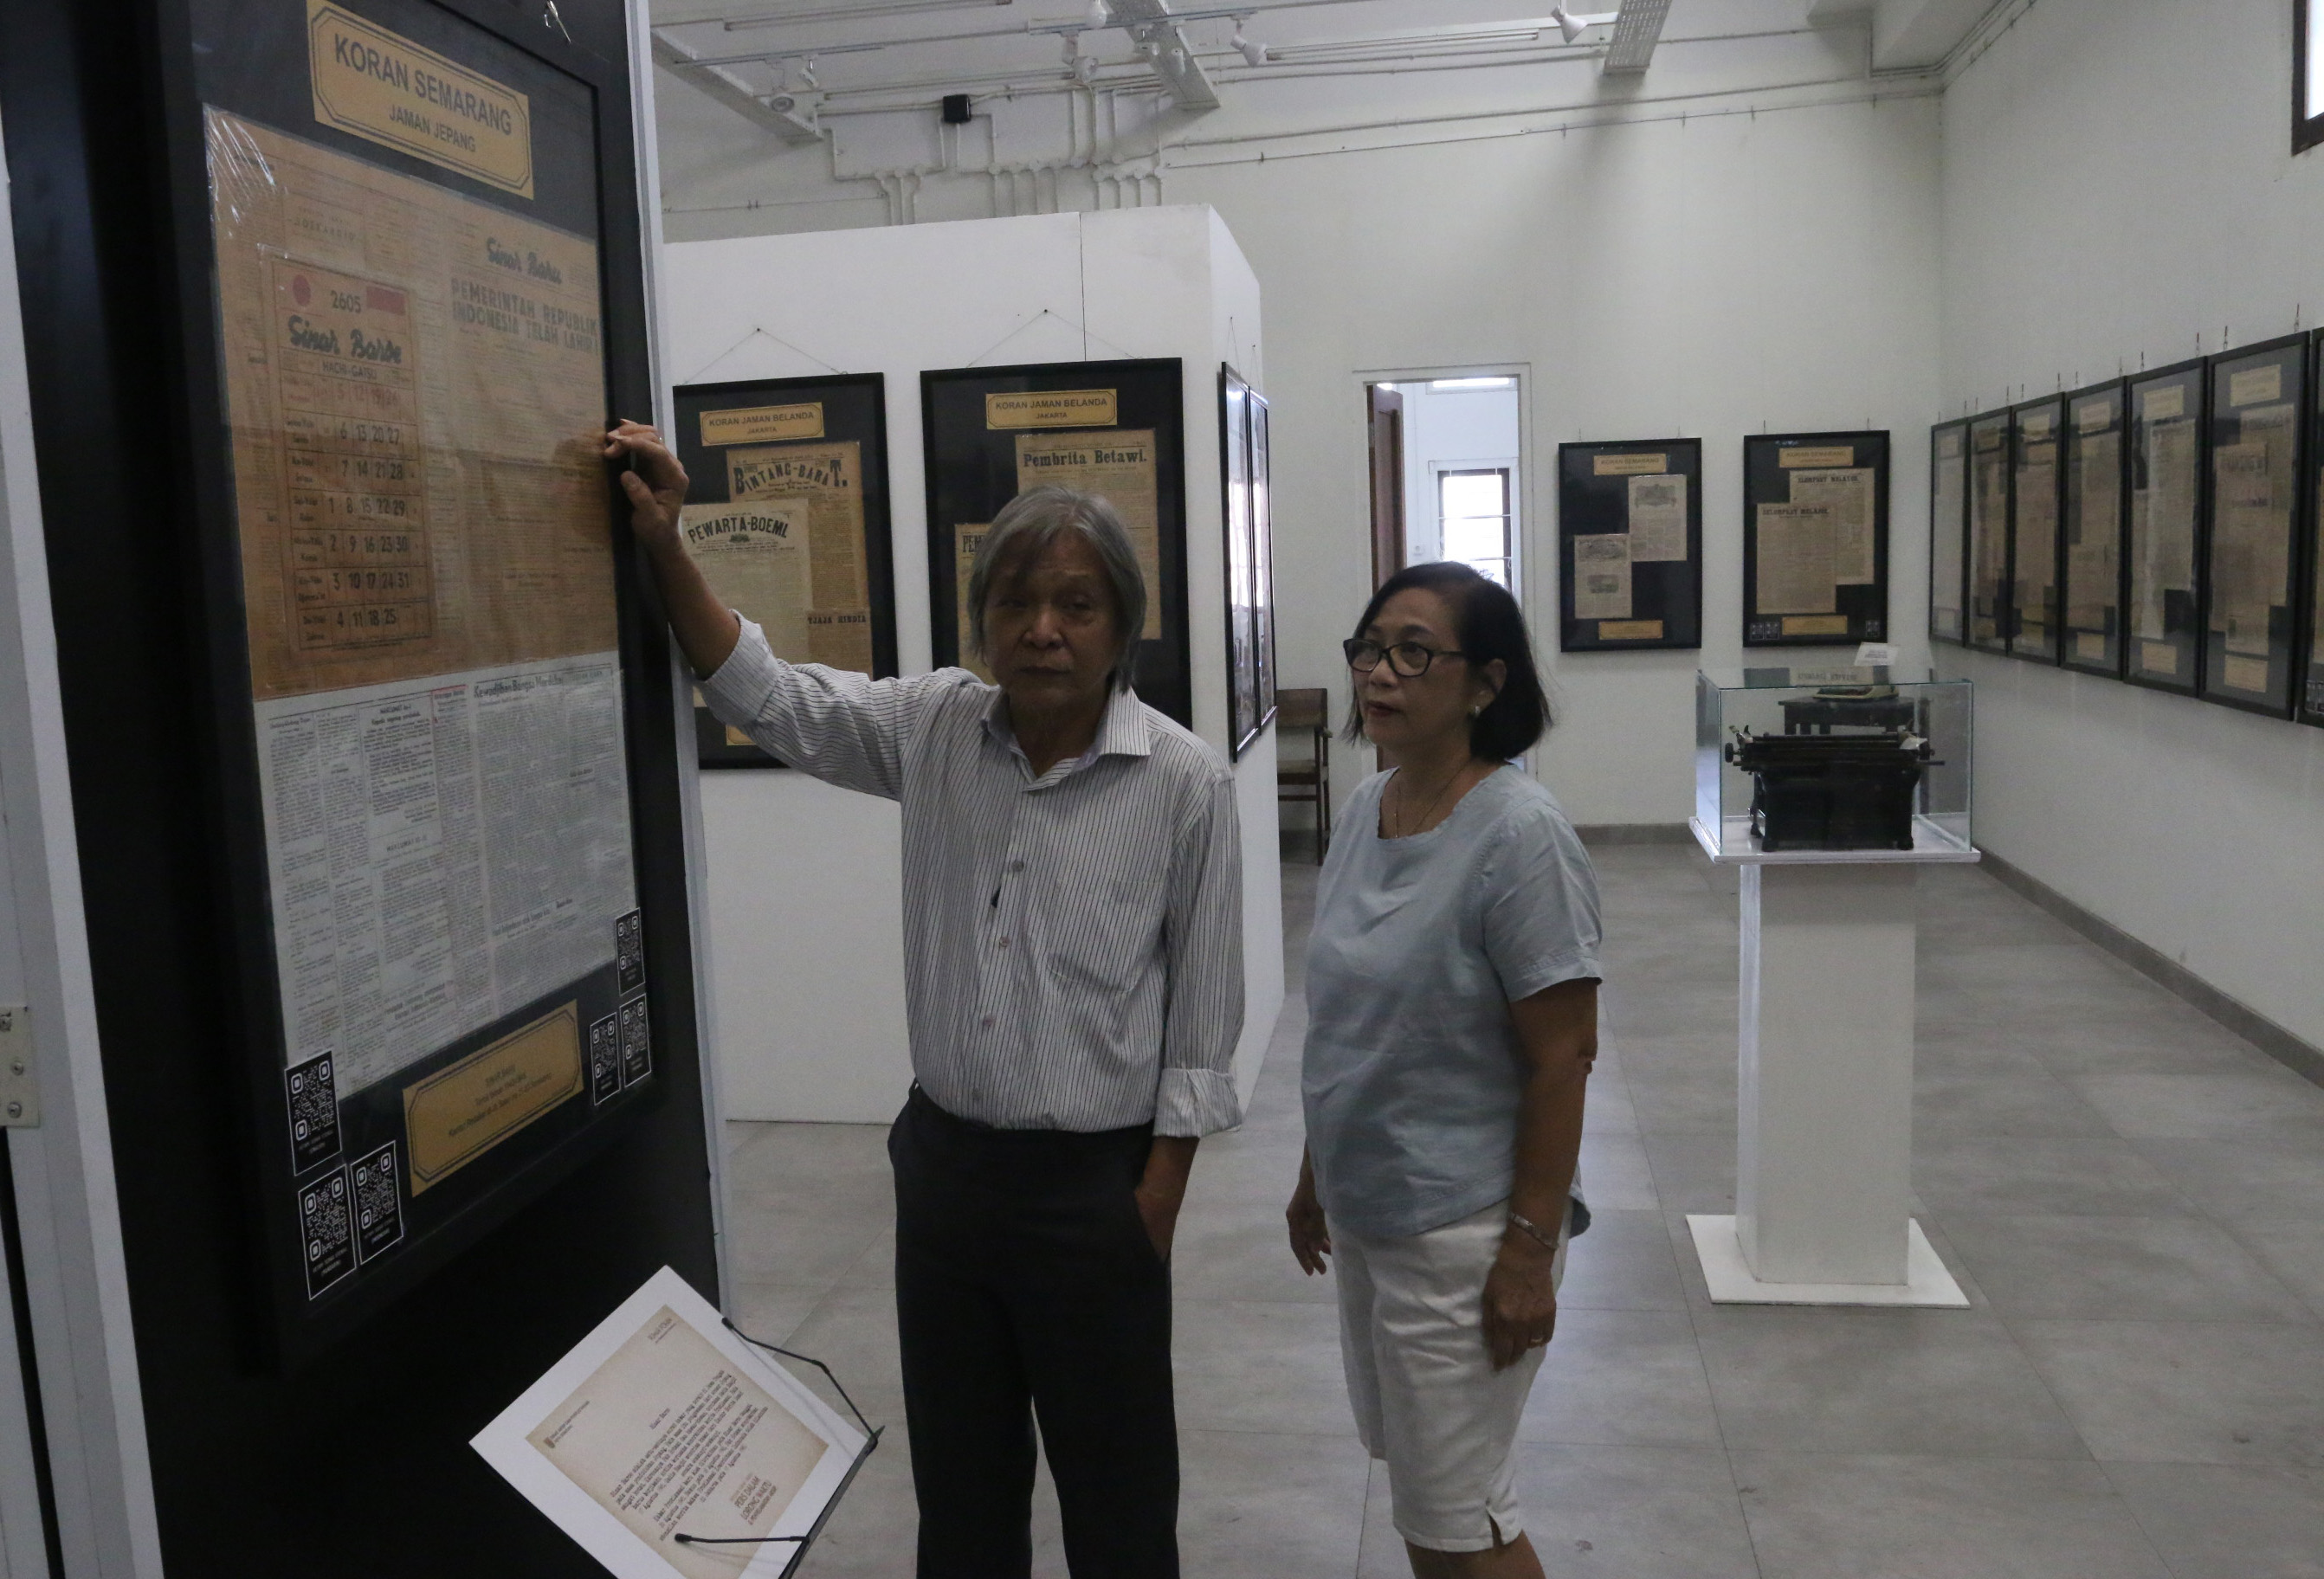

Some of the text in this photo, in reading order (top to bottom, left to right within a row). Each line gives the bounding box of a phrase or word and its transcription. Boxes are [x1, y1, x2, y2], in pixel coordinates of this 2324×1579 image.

[334, 33, 513, 136] KORAN SEMARANG
[389, 104, 476, 154] JAMAN JEPANG
[331, 288, 362, 314] 2605
[451, 277, 597, 336] PEMERINTAH REPUBLIK
[453, 300, 520, 334] INDONESIA
[526, 319, 559, 345] TELAH
[996, 396, 1107, 410] KORAN JAMAN BELANDA
[709, 411, 815, 427] KORAN JAMAN BELANDA
[339, 423, 400, 444] 6 13 20 27
[747, 426, 778, 435] JAKARTA
[1023, 452, 1088, 467] Pembrita
[356, 460, 368, 477] 14
[390, 462, 403, 480] 28
[328, 497, 334, 514] 1
[346, 497, 354, 514] 8
[360, 497, 372, 514] 15
[376, 499, 390, 515] 22
[391, 499, 406, 517] 29
[329, 535, 337, 552] 2
[349, 535, 357, 552] 9
[364, 536, 376, 553] 16
[379, 536, 393, 553] 23
[396, 536, 410, 553] 30
[332, 573, 340, 590] 3
[347, 572, 361, 590] 10
[365, 572, 377, 590] 17
[381, 572, 394, 590] 24
[397, 572, 410, 589] 31
[337, 611, 345, 628] 4
[352, 611, 364, 628] 11
[367, 609, 379, 626] 18
[383, 608, 397, 625] 25
[808, 615, 866, 625] TJAJA HINDIA
[733, 1474, 760, 1509] PERS DALAM
[739, 1495, 760, 1520] LORONG
